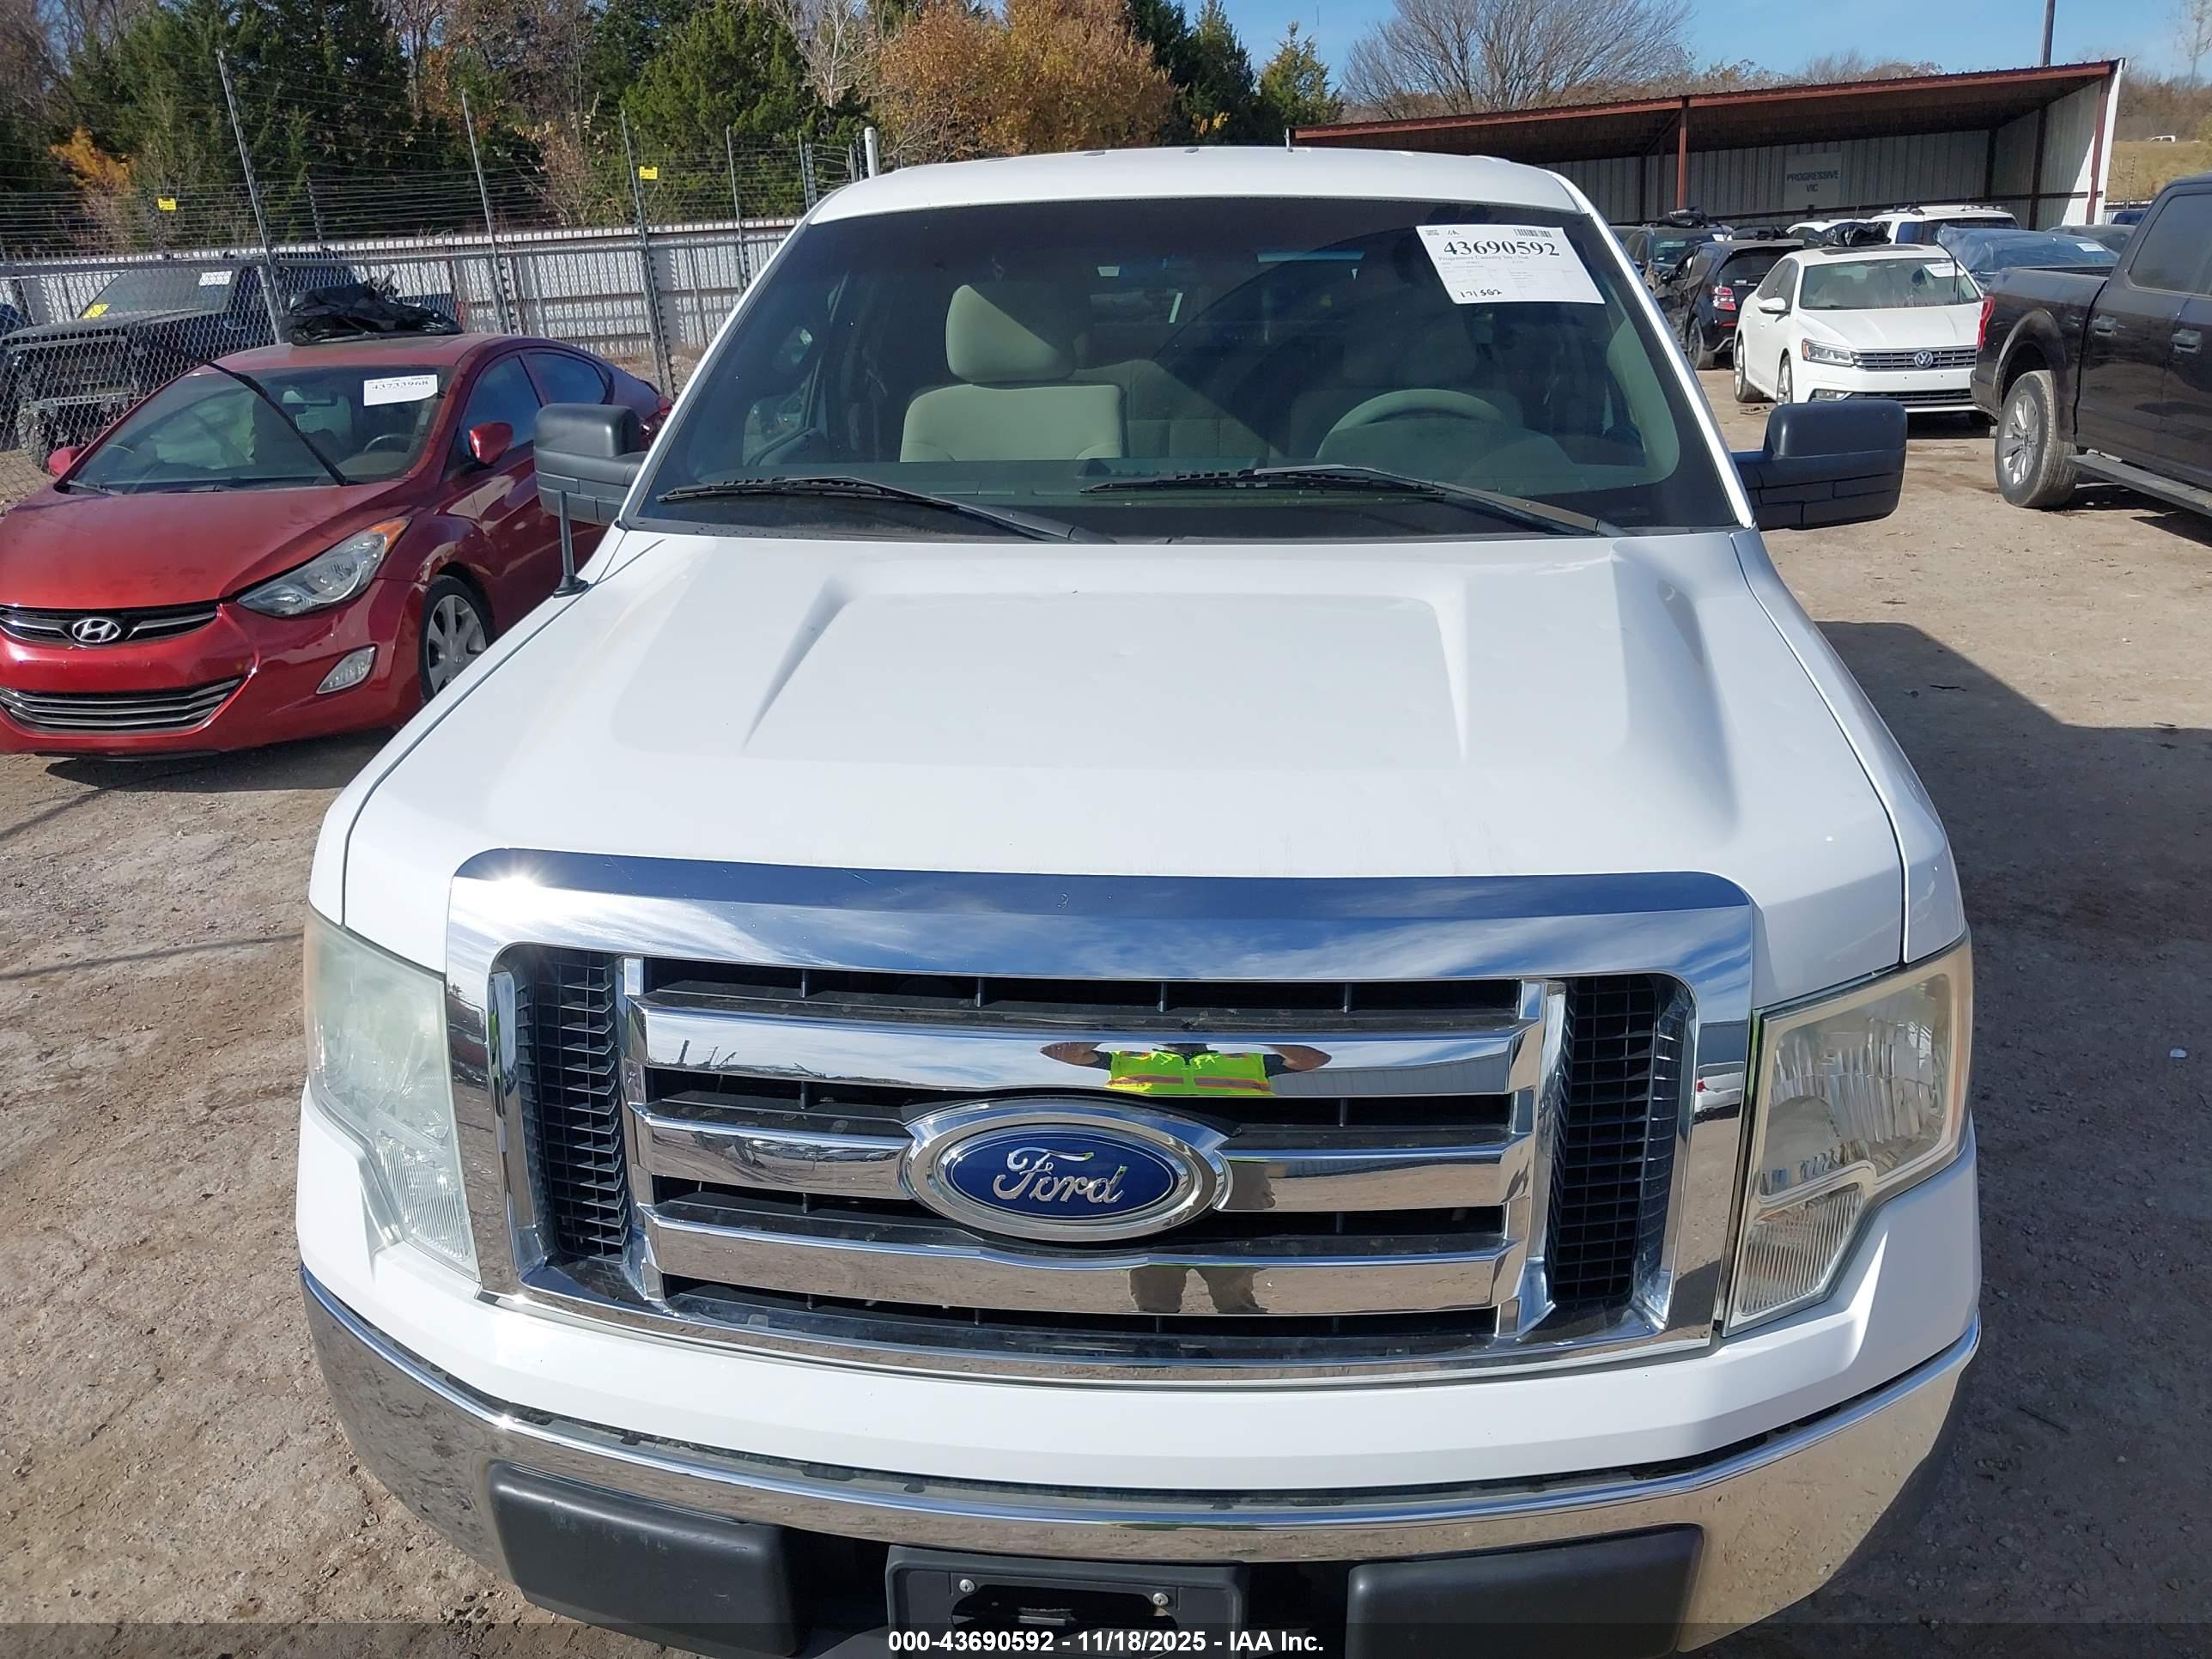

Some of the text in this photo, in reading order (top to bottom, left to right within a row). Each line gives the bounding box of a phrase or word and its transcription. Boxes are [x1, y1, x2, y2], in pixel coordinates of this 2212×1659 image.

[1786, 170, 1839, 181] PROGRESSIVE
[1443, 240, 1560, 257] 43690592
[992, 1146, 1127, 1204] Ford
